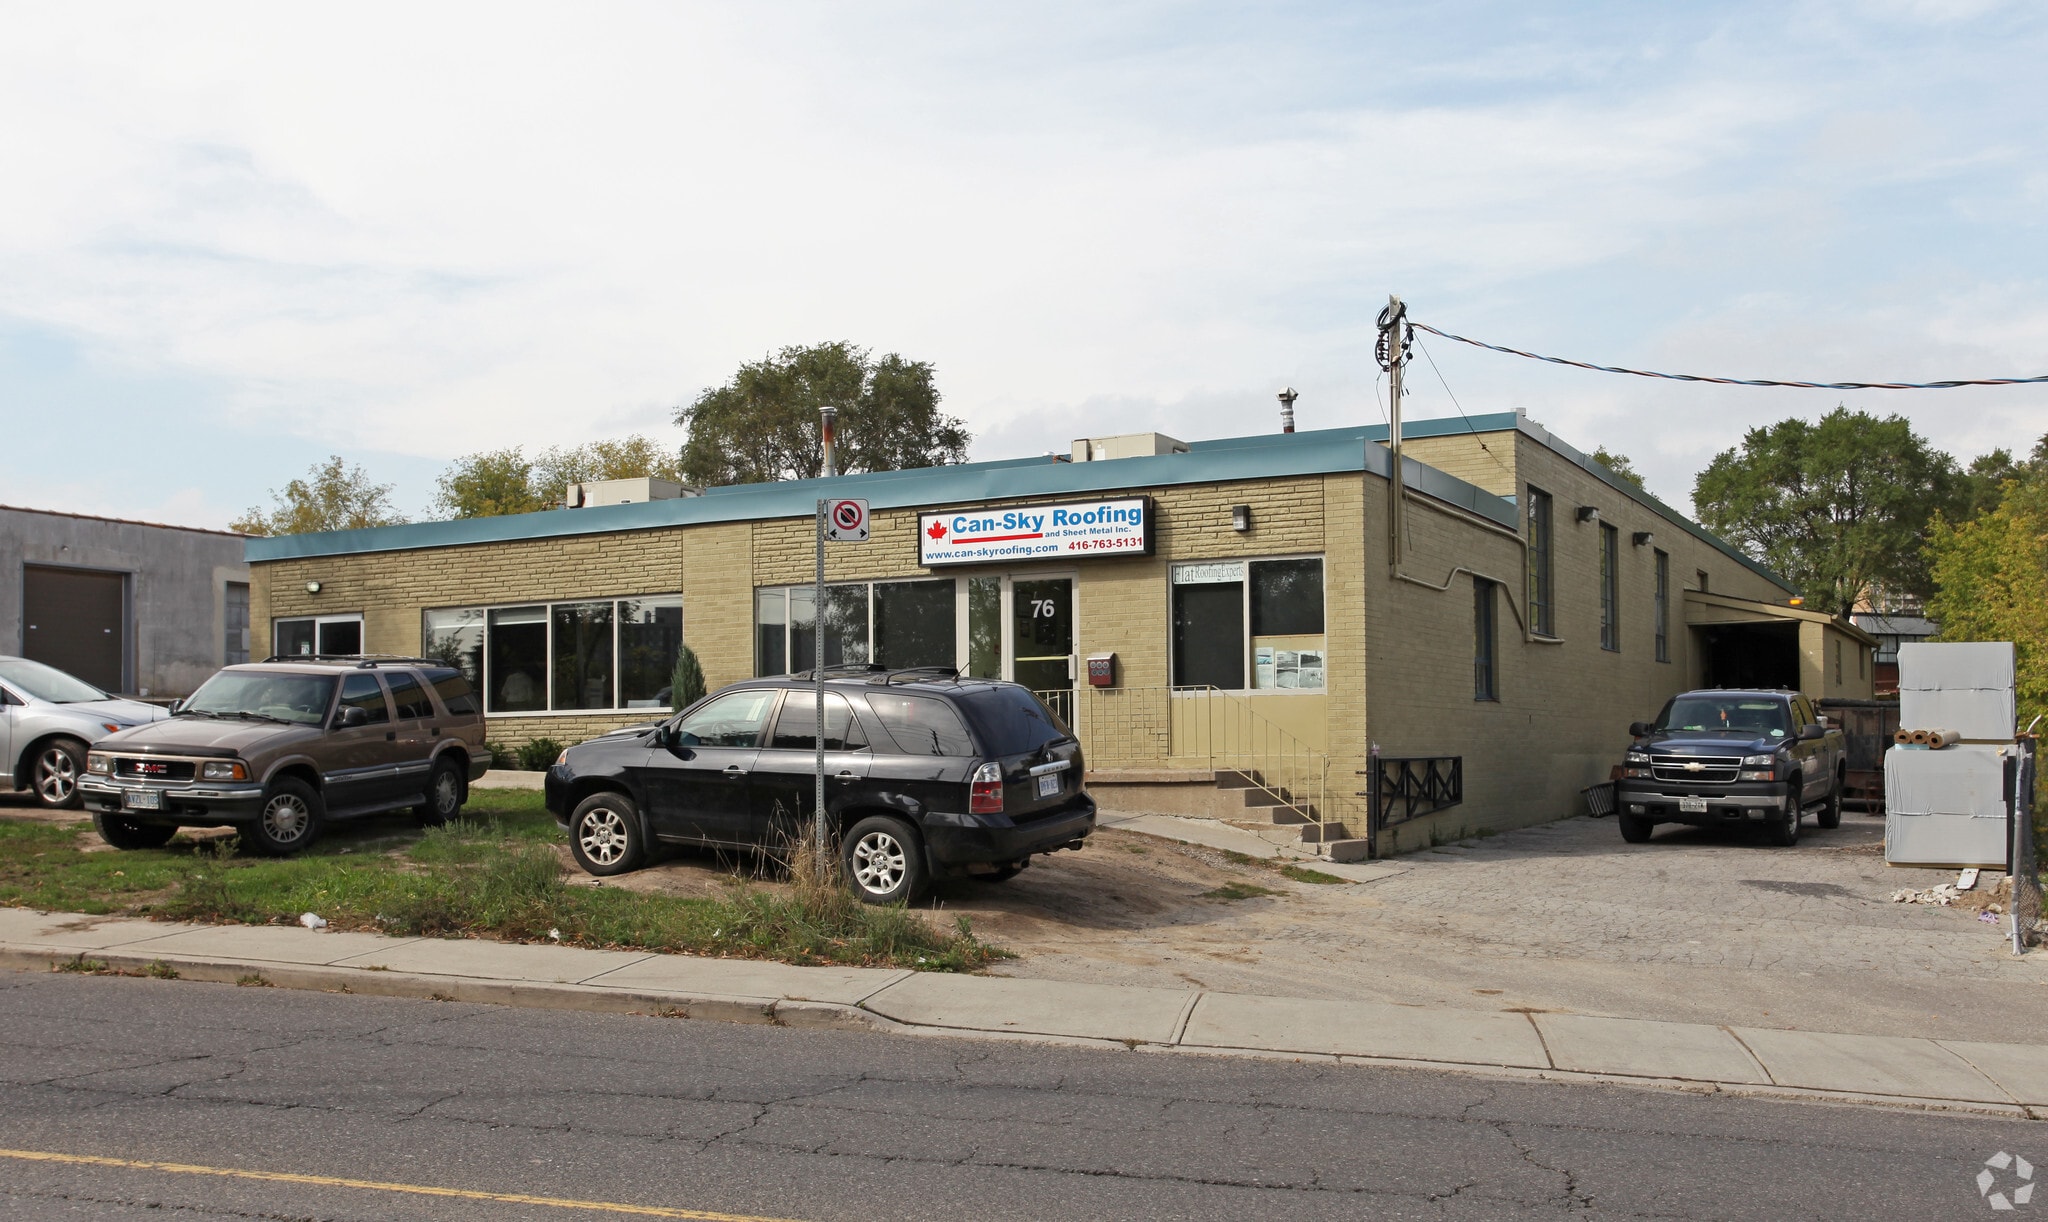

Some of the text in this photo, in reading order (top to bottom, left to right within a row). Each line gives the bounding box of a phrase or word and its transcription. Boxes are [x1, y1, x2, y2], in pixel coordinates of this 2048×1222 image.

[952, 506, 1142, 533] Can-Sky Roofing
[1045, 525, 1132, 538] and Sheet Metal Inc.
[1068, 536, 1142, 550] 416-763-5131
[925, 544, 1058, 560] www.can-skyroofing.com
[1173, 565, 1194, 583] Flat
[1030, 598, 1055, 618] 76
